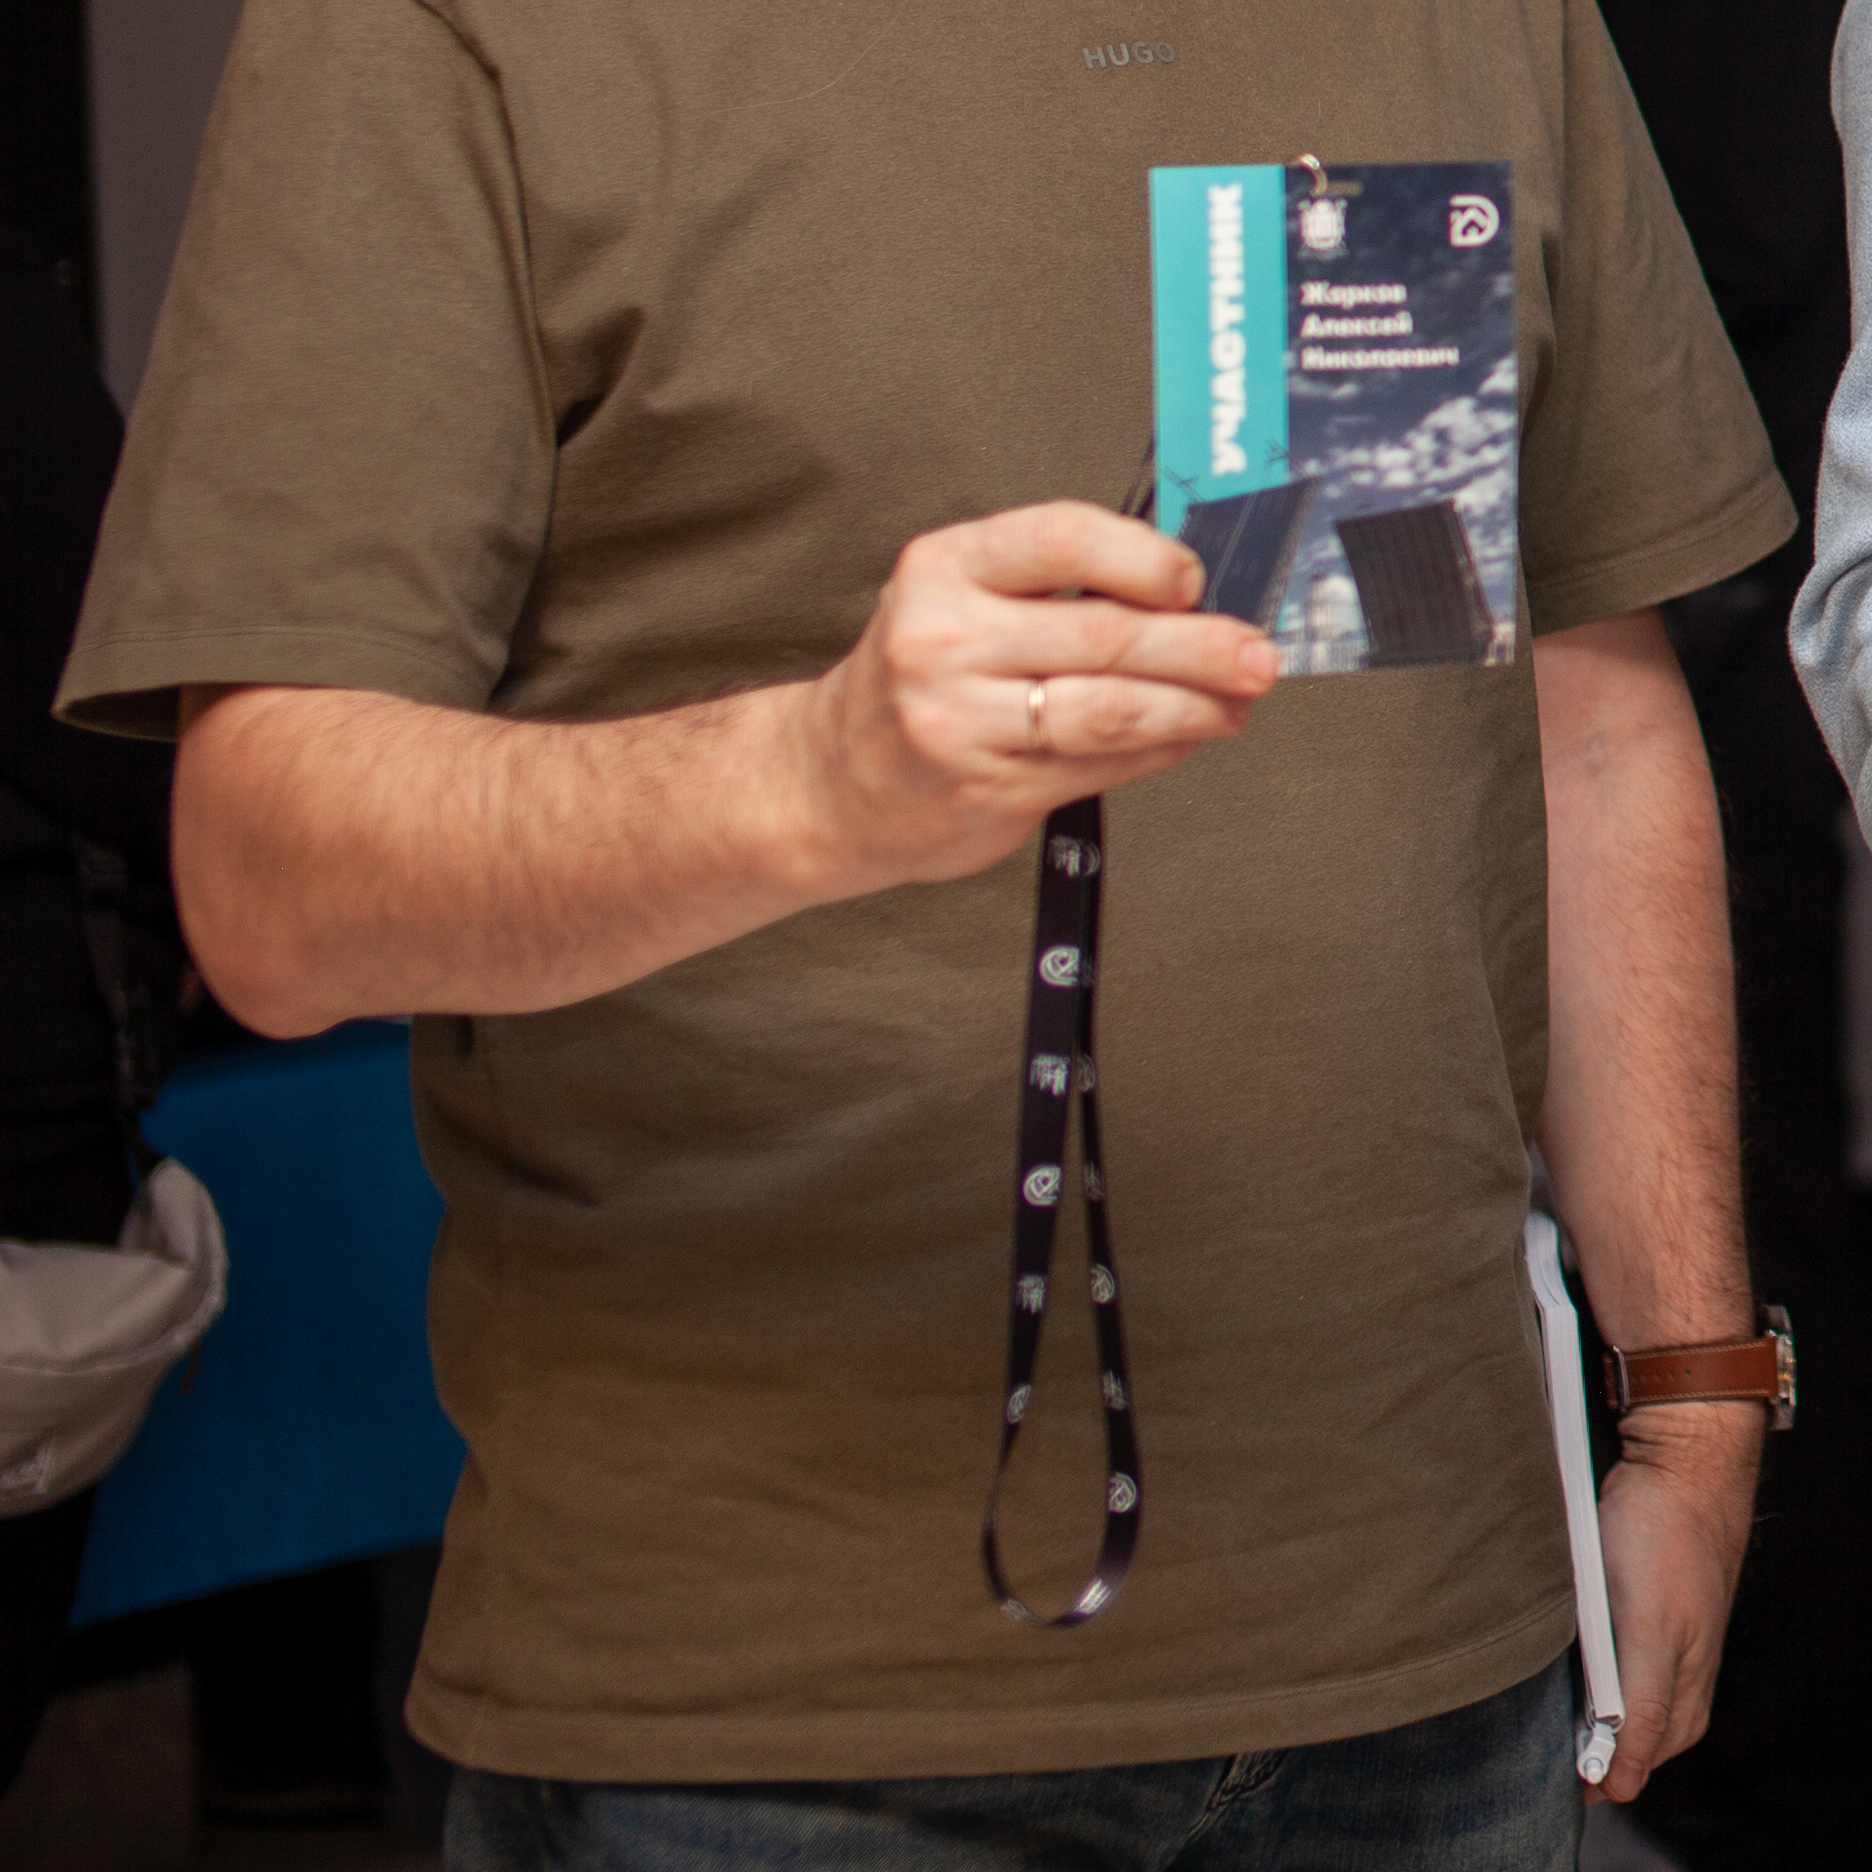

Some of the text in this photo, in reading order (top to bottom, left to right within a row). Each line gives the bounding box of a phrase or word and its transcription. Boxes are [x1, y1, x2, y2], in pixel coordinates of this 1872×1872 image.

[1082, 39, 1176, 69] HUGO
[1207, 182, 1247, 476] УЧАСТНИК
[1301, 310, 1413, 338] Алексей
[1302, 345, 1460, 371] Николаевич
